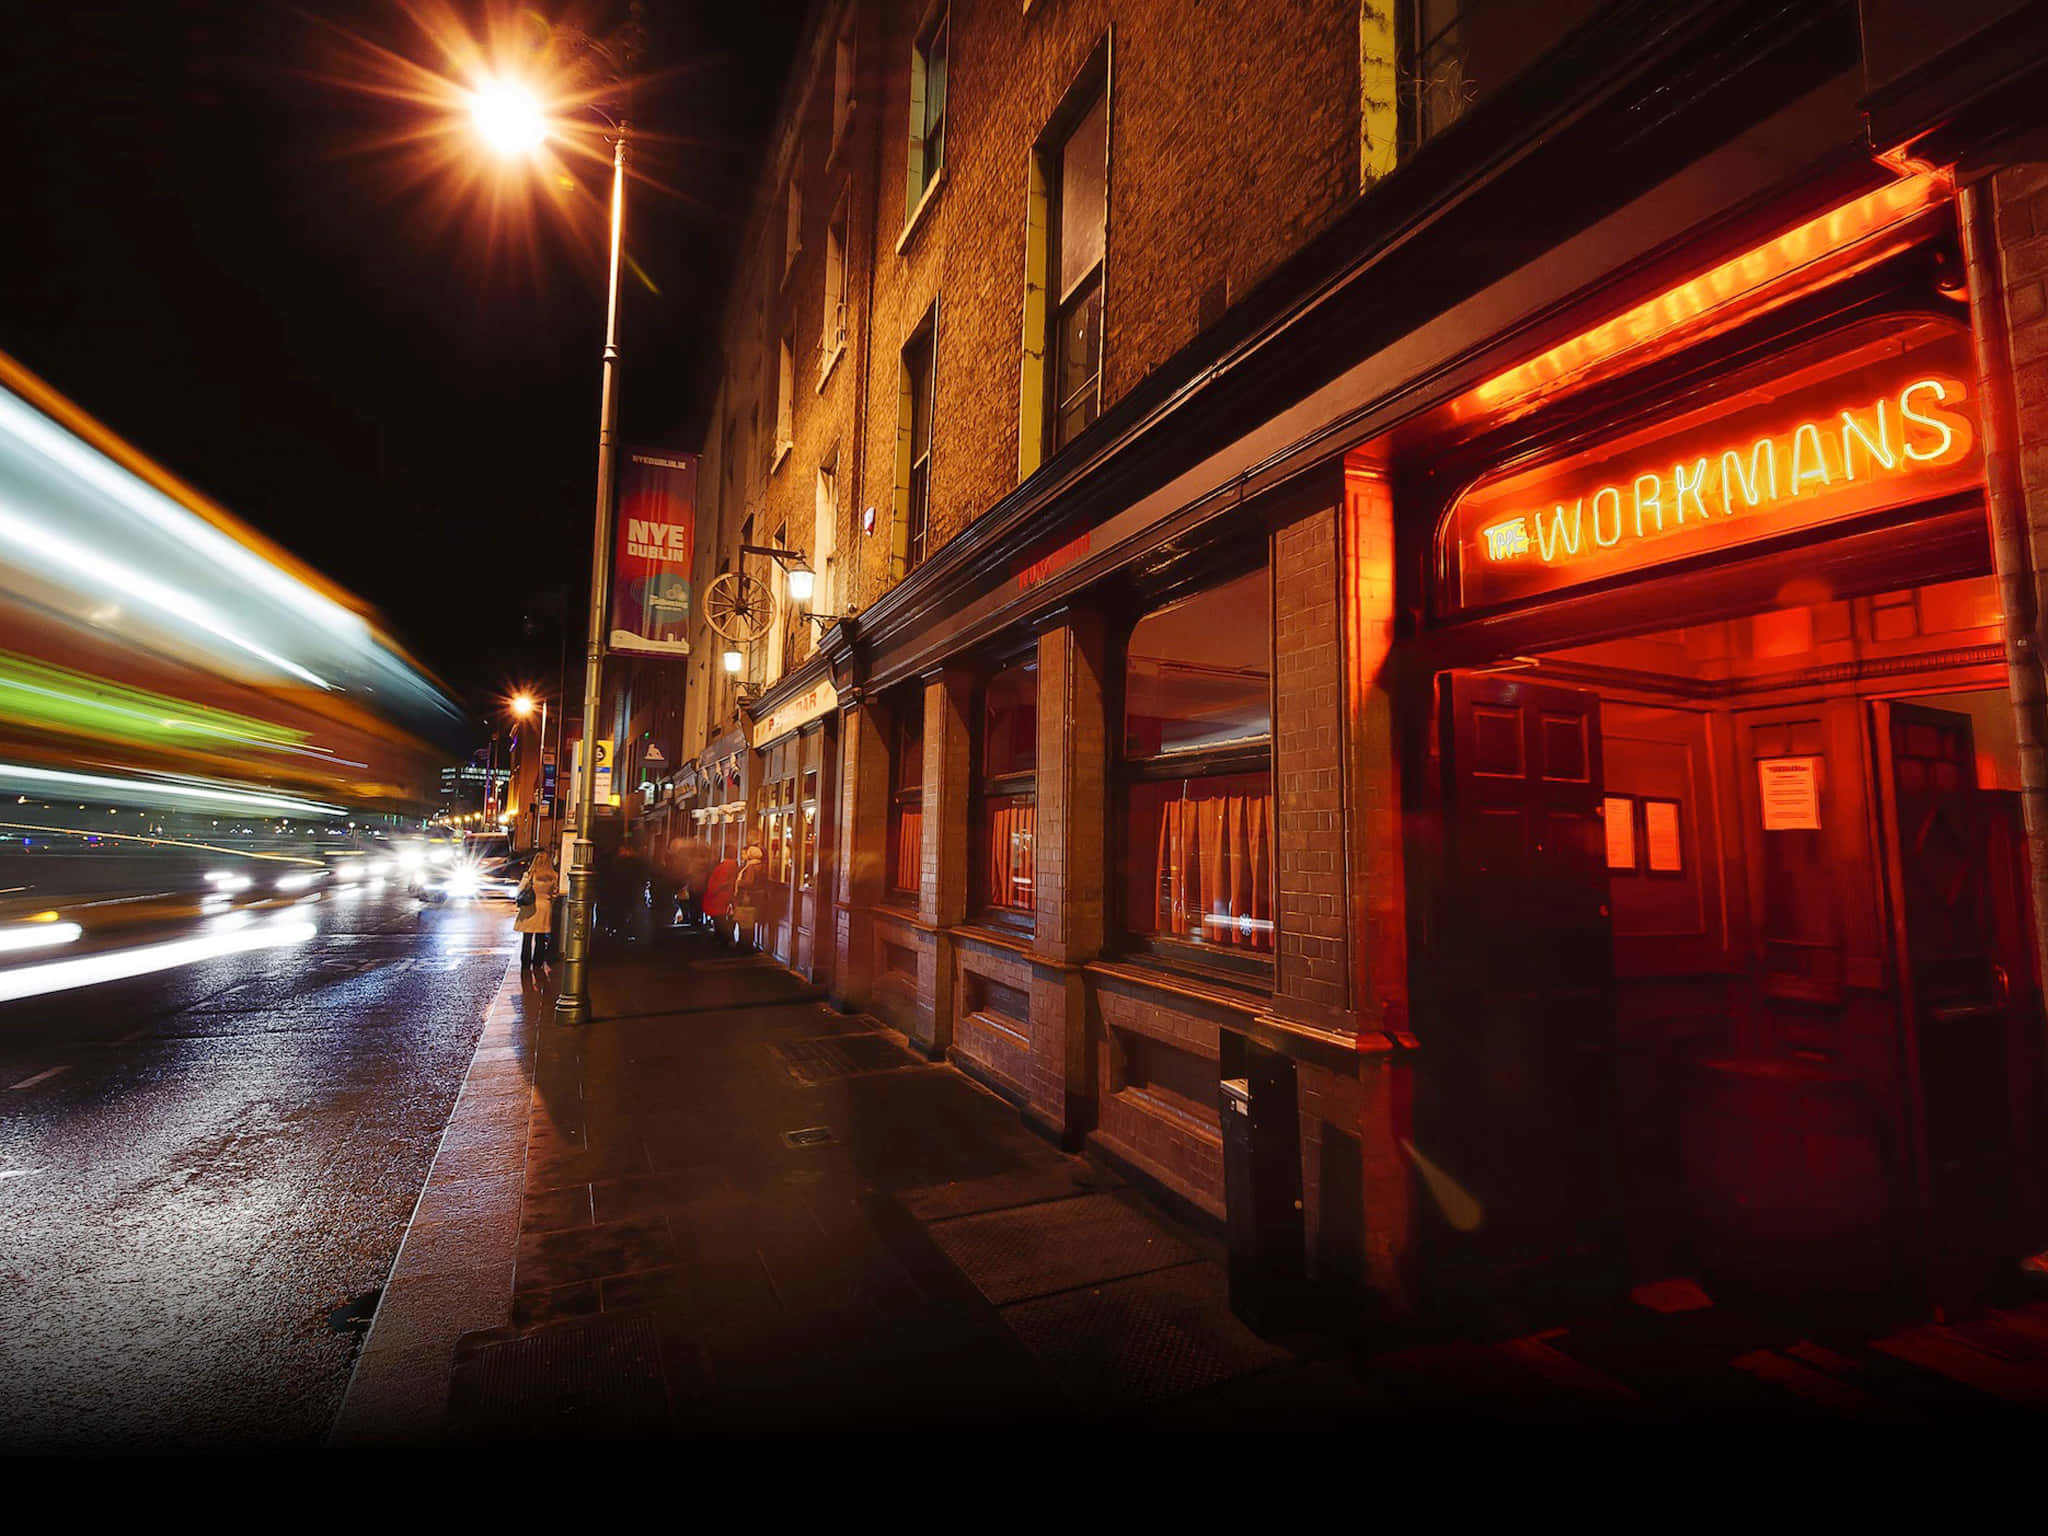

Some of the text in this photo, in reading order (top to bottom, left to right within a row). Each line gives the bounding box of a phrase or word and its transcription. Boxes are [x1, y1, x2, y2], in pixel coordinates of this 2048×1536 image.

[1485, 380, 1955, 563] THE WORKMANS
[627, 518, 685, 548] NYE
[626, 542, 684, 562] DUBLIN
